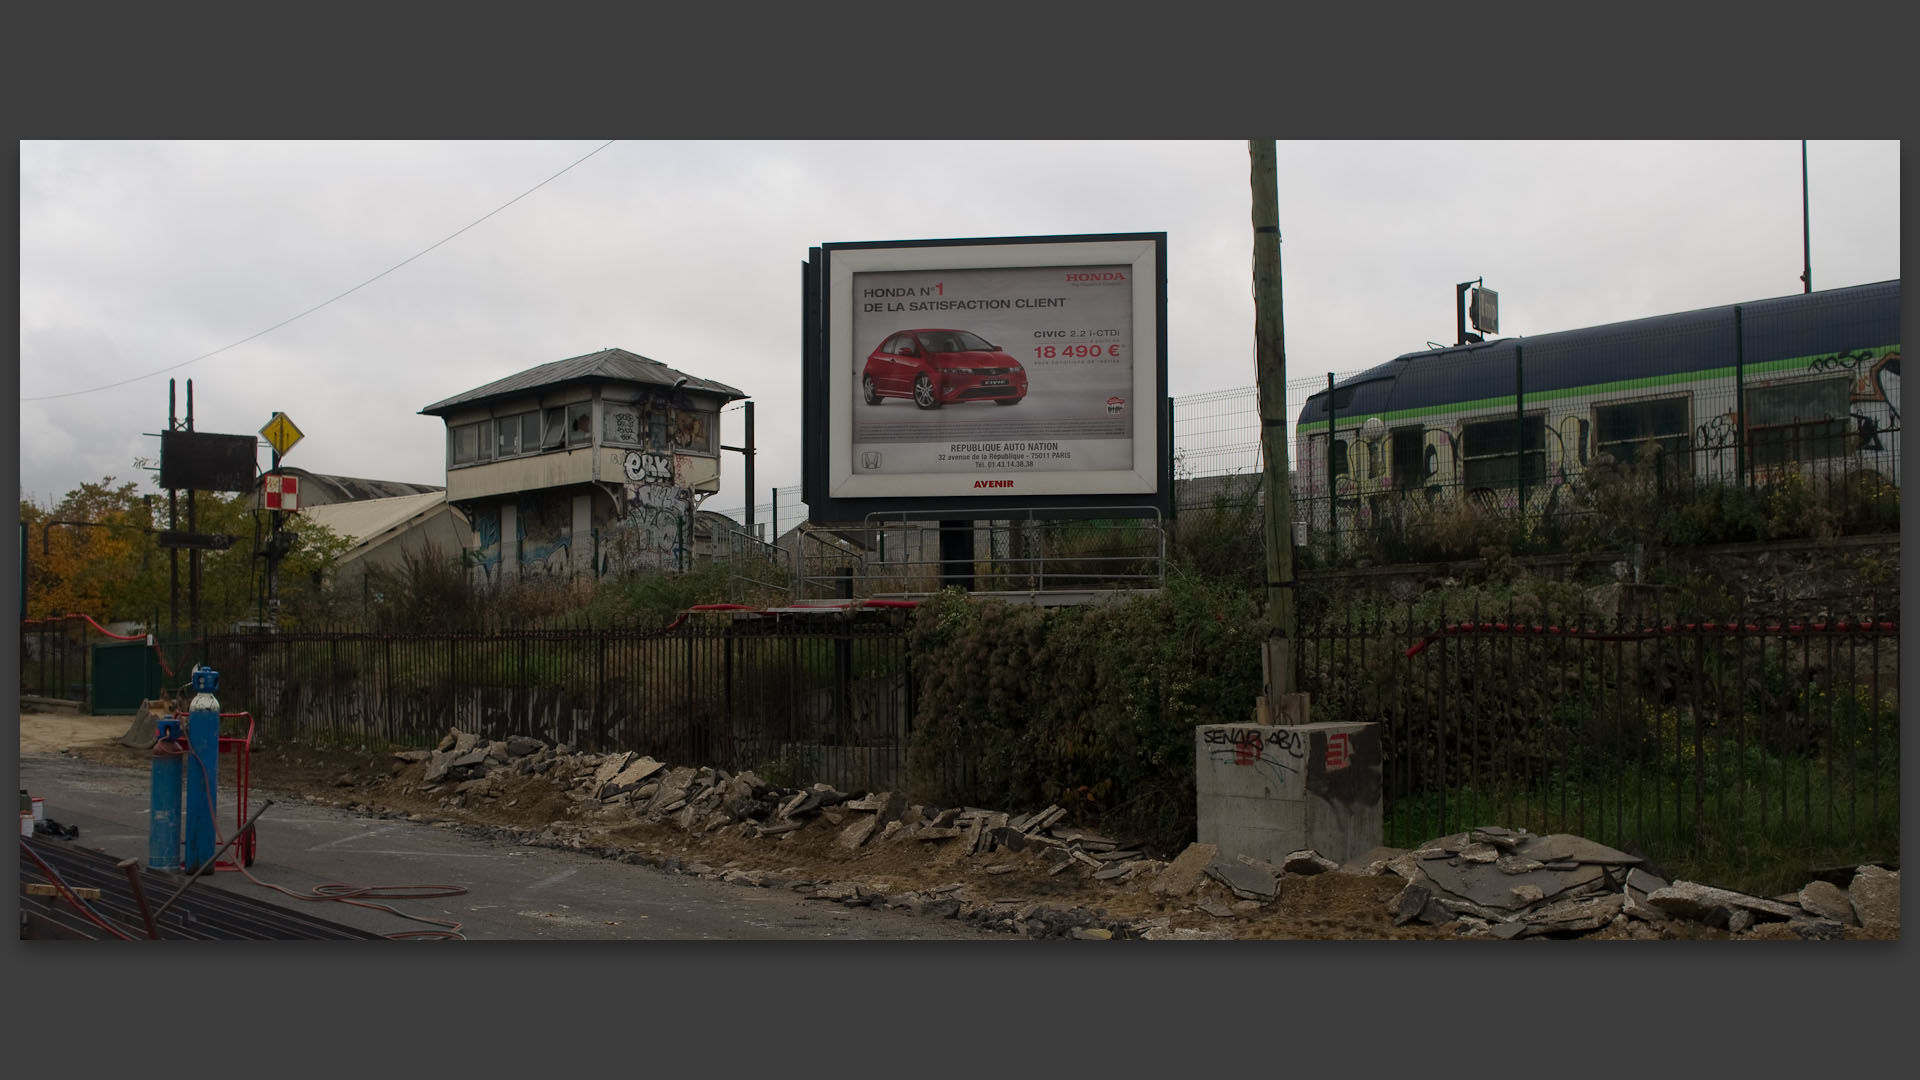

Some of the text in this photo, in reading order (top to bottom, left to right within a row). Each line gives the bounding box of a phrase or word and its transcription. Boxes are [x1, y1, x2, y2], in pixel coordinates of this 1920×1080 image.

[1066, 272, 1127, 282] HONDA
[864, 287, 916, 298] HONDA
[864, 303, 883, 313] DE
[887, 302, 905, 312] LA
[909, 298, 1011, 311] SATISFACTION
[1033, 330, 1066, 338] CIVIC
[1034, 344, 1120, 359] 18 490 €
[950, 442, 1058, 453] REPUBLIQUE AUTO NATION
[989, 453, 1025, 461] République
[973, 480, 1014, 489] AVENIR
